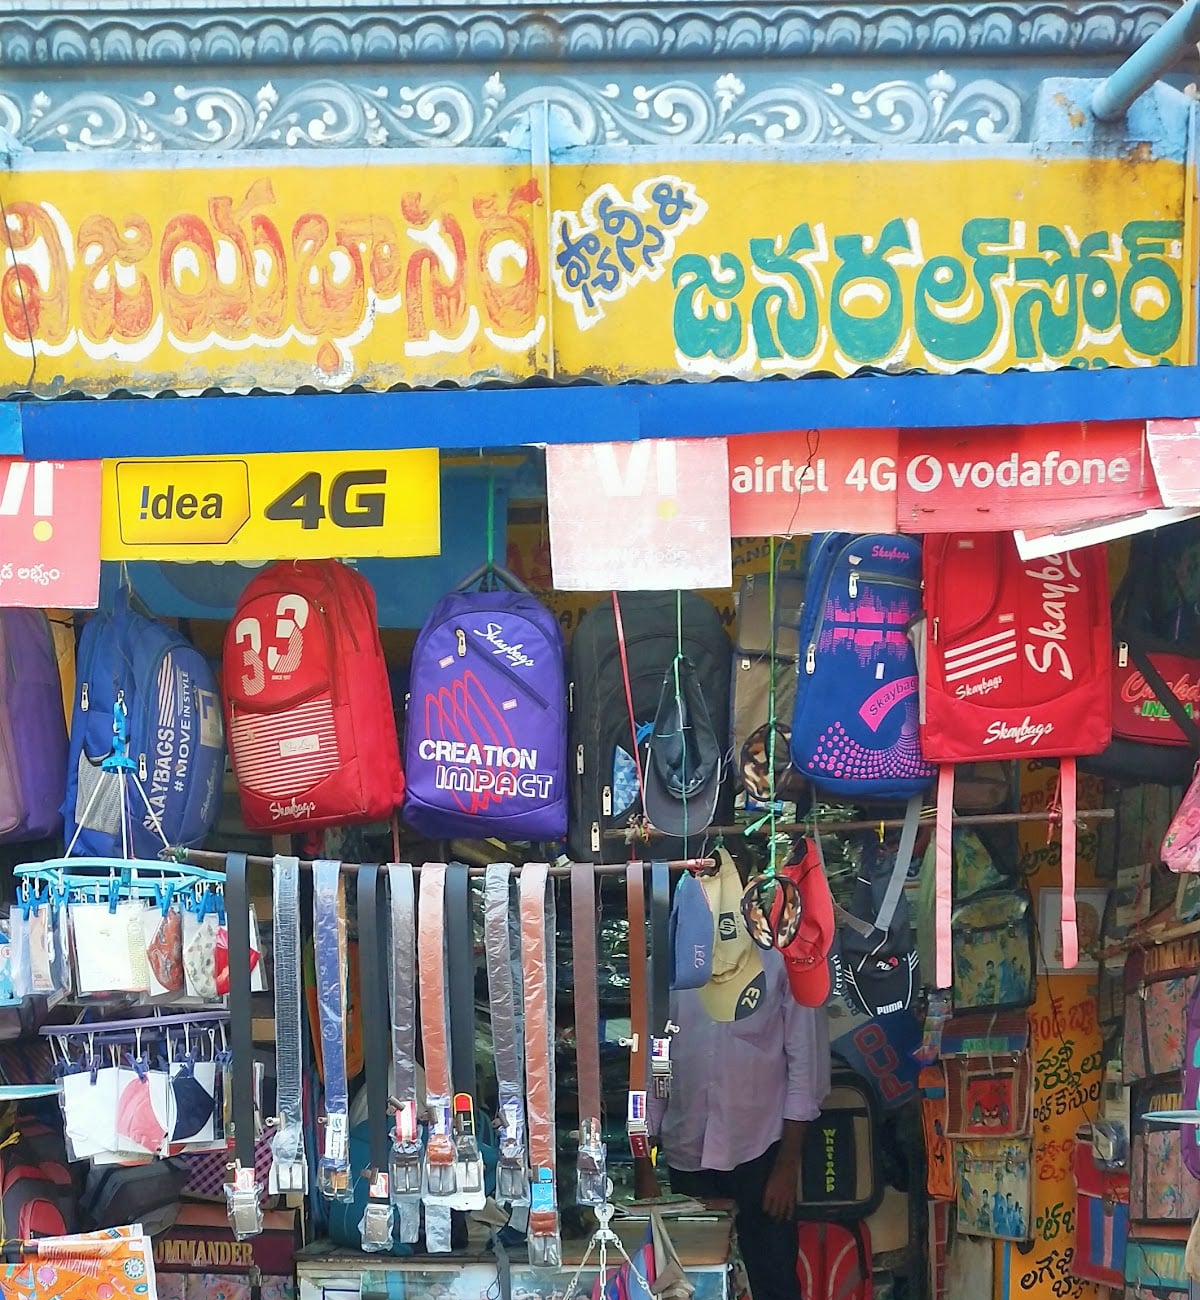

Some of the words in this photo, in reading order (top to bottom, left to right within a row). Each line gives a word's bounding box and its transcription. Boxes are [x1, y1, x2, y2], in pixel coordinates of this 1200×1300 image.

[732, 456, 829, 493] airtel
[844, 455, 897, 492] 4G
[947, 451, 1131, 489] vodafone
[264, 469, 387, 529] 4G
[17, 563, 60, 586] లభ్యం
[473, 622, 535, 667] Skaybags
[869, 680, 918, 716] Skaybag
[955, 675, 1004, 700] Skaybags
[181, 705, 191, 718] IN
[983, 716, 1055, 746] Skaybags
[419, 739, 538, 770] CREATION
[143, 728, 175, 833] SKAYBAGS
[435, 765, 553, 799] IMPACT
[830, 953, 843, 997] Ferrari
[741, 987, 761, 1009] 23
[876, 1001, 904, 1016] PUMA
[154, 1239, 254, 1267] OMMANDER
